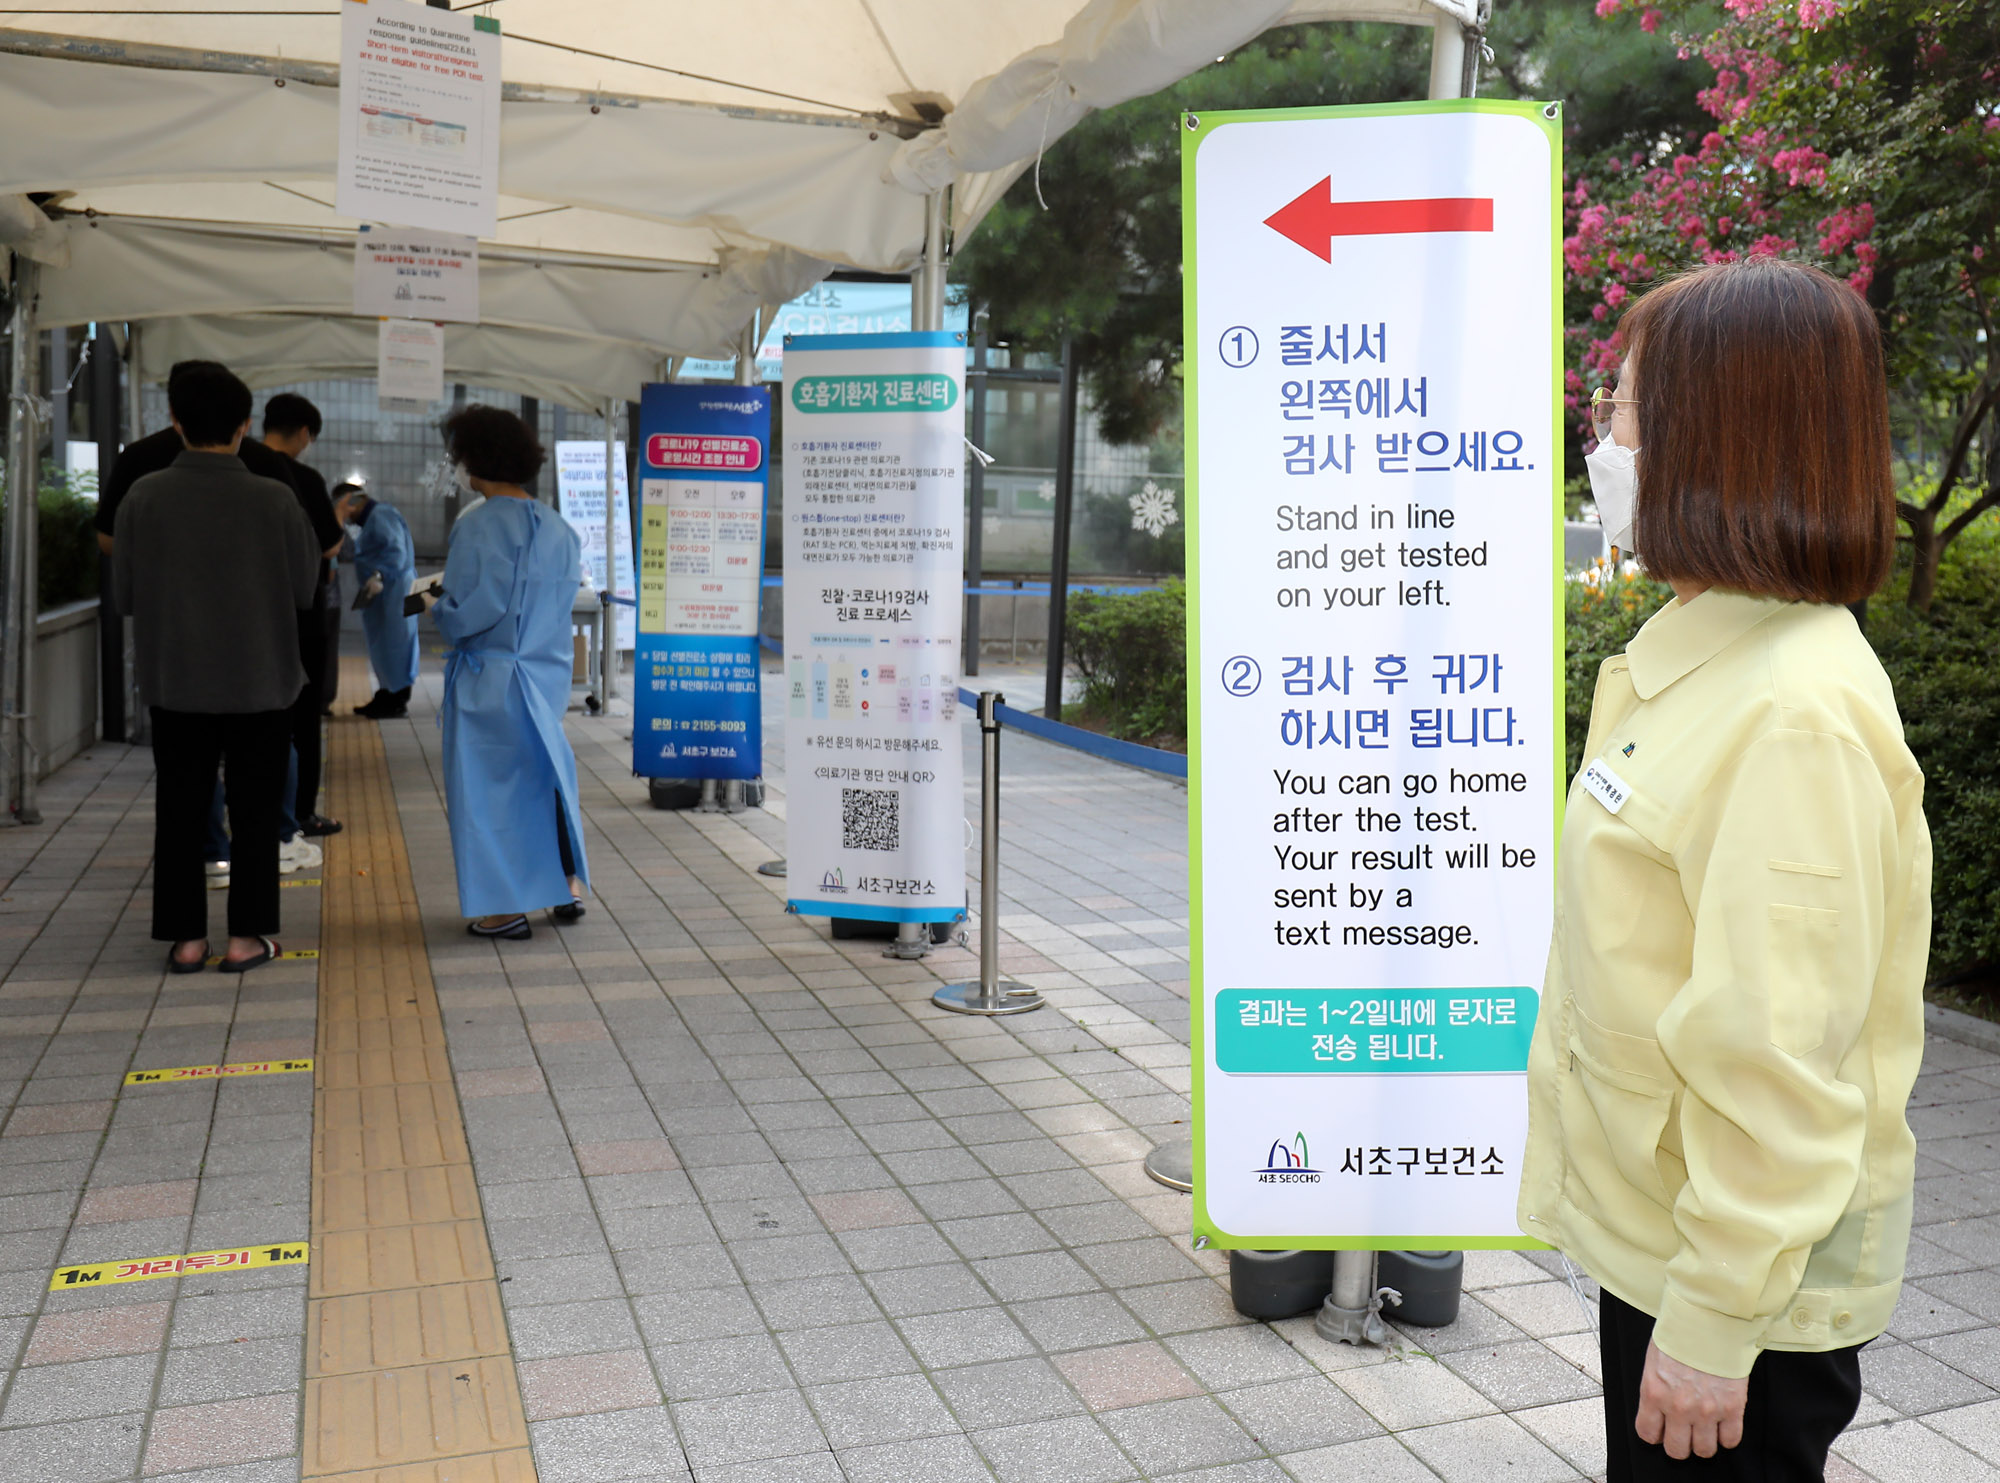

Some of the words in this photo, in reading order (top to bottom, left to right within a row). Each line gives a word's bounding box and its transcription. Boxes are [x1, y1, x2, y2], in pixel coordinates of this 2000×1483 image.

[370, 28, 406, 40] response
[377, 16, 415, 31] According
[419, 25, 427, 33] to
[430, 28, 470, 42] Quarantine
[367, 40, 408, 54] Short-term
[360, 51, 372, 59] are
[376, 54, 388, 62] not
[392, 57, 417, 68] eligible
[421, 62, 431, 70] for
[435, 65, 449, 75] free
[453, 70, 466, 78] PCR
[1279, 322, 1387, 366] 줄서서
[798, 380, 879, 407] 호흡기환자
[883, 380, 948, 406] 진료센터
[1279, 376, 1428, 421] 왼쪽에서
[801, 442, 838, 451] 호흡기환자
[841, 442, 882, 450] 진료센터란?
[1282, 433, 1356, 476] 검사
[1376, 430, 1535, 473] 받으세요.
[726, 454, 745, 466] 안내
[820, 456, 851, 465] 코로나19
[870, 456, 901, 465] 의료기관
[846, 494, 875, 503] 의료기관
[864, 513, 905, 523] 진료센터란?
[1276, 504, 1358, 532] Stand
[1370, 505, 1394, 529] in
[1406, 503, 1455, 529] line
[803, 528, 839, 537] 호흡기환자
[842, 528, 871, 537] 진료센터
[898, 528, 932, 537] 코로나19
[935, 528, 950, 537] 검사
[803, 540, 820, 549] (RAT
[883, 553, 914, 563] 의료기관
[1276, 543, 1328, 569] and
[1340, 542, 1386, 573] get
[1398, 541, 1487, 568] tested
[821, 588, 930, 605] 진찰·코로나19검사
[1276, 587, 1310, 608] on
[1324, 586, 1386, 610] your
[1398, 580, 1450, 606] left.
[836, 608, 859, 621] 진료
[863, 608, 912, 622] 프로세스
[1281, 655, 1354, 696] 검사
[1373, 654, 1409, 695] 후
[1432, 653, 1503, 694] 귀가
[692, 720, 746, 732] 2155-8093
[1280, 709, 1390, 749] 하시면
[1409, 707, 1525, 748] 됩니다.
[816, 736, 834, 748] 유선
[836, 736, 853, 749] 문의
[856, 737, 881, 750] 하시고
[884, 739, 943, 752] 방문해주세요.
[864, 769, 884, 782] 명단
[888, 770, 908, 783] 안내
[1273, 769, 1325, 795] You
[1338, 773, 1390, 794] can
[1403, 773, 1437, 798] go
[1449, 768, 1527, 793] home
[1273, 807, 1342, 833] after
[1356, 807, 1401, 832] the
[1414, 806, 1477, 831] test.
[1273, 845, 1338, 870] Your
[1351, 844, 1433, 870] result
[1445, 844, 1489, 869] will
[1502, 843, 1536, 868] be
[857, 877, 936, 895] 서초구보건소
[1273, 882, 1337, 908] sent
[1349, 882, 1383, 911] by
[1395, 887, 1413, 908] a
[1274, 920, 1330, 946] text
[1343, 924, 1479, 949] message.
[1239, 1000, 1307, 1027] 결과는
[1318, 998, 1436, 1026] 1~2일내에
[1448, 998, 1517, 1026] 문자로
[1311, 1034, 1358, 1061] 전송
[1368, 1033, 1444, 1061] 됩니다.
[132, 1072, 161, 1081] 1M
[171, 1062, 271, 1078] 거리두기
[280, 1062, 308, 1071] 1M
[1339, 1146, 1504, 1176] 서초구보건소
[1258, 1174, 1277, 1183] 서초
[1278, 1173, 1321, 1184] SEOCHO
[59, 1269, 102, 1284] 1M
[114, 1250, 251, 1279] 거리두기
[262, 1247, 302, 1261] 1M
